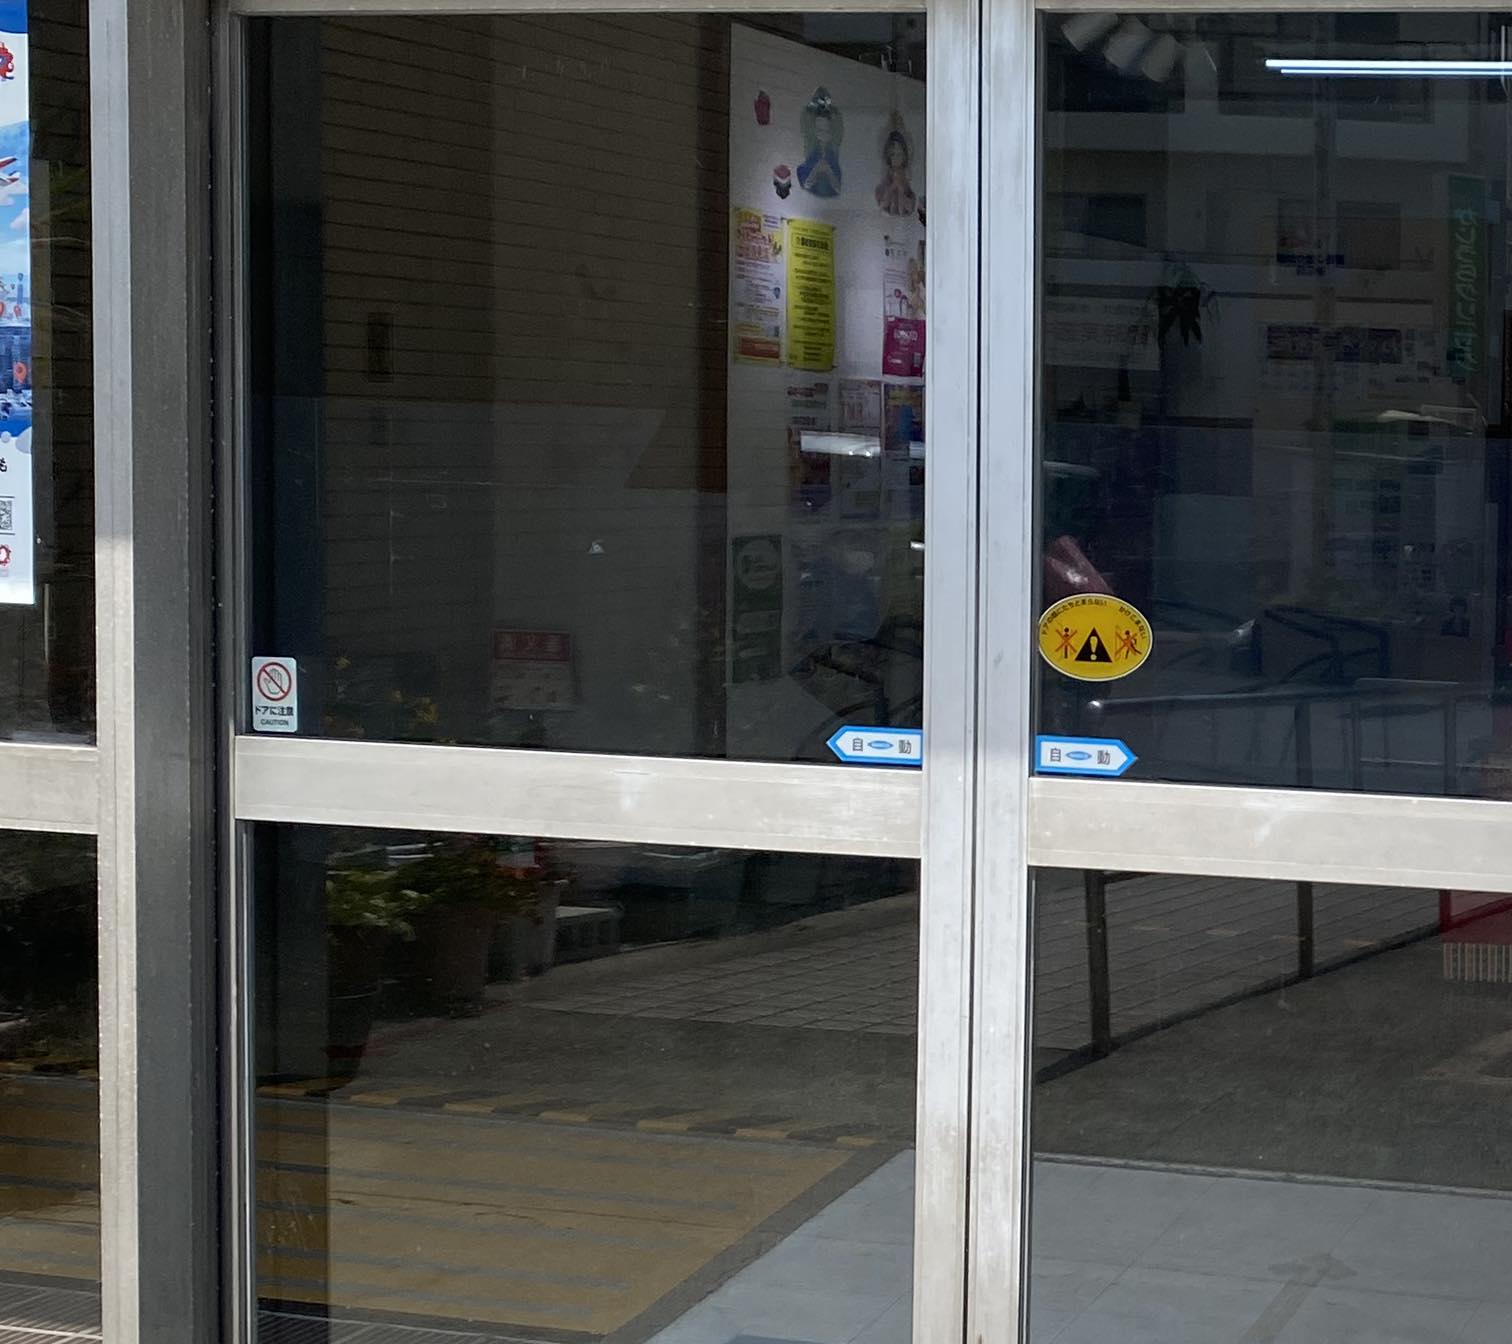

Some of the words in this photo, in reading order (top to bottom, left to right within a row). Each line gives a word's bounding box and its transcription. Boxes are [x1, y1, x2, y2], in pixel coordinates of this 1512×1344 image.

[254, 705, 294, 717] ドアに注意
